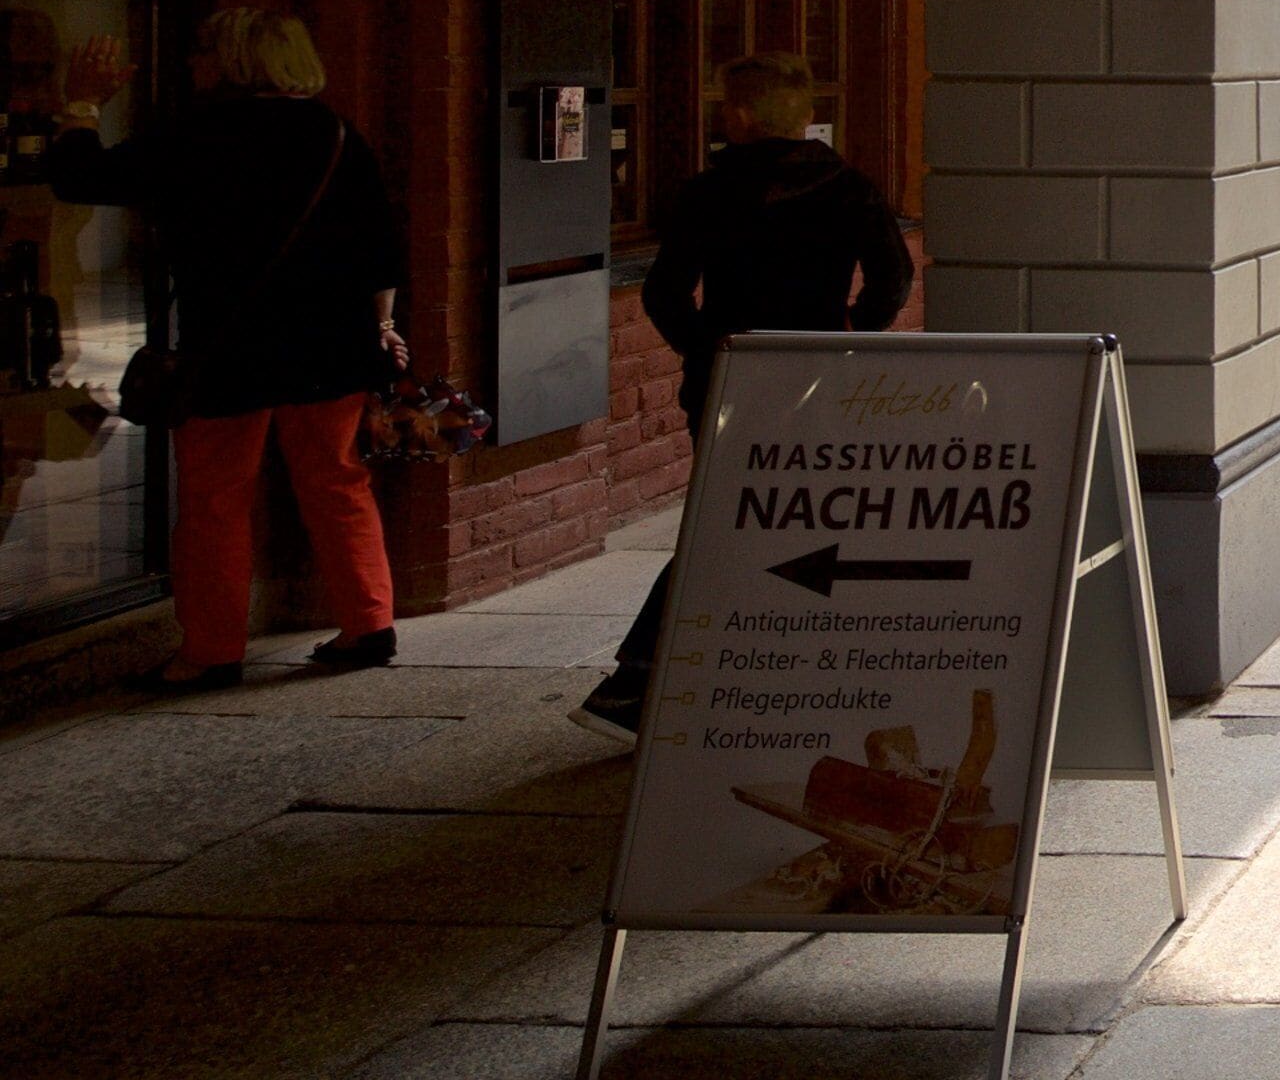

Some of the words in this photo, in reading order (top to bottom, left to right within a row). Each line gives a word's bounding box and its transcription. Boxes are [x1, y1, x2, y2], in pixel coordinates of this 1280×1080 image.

[839, 372, 957, 425] Holz66
[747, 437, 1036, 471] MASSIVMÖBEL
[734, 486, 895, 531] NACH
[723, 609, 1022, 638] Antiquitätenrestaurierung
[717, 647, 809, 671] Polster-
[817, 648, 838, 671] &
[845, 648, 1008, 671] Flechtarbeiten
[710, 686, 892, 716] Pflegeprodukte
[702, 726, 831, 749] Korbwaren
